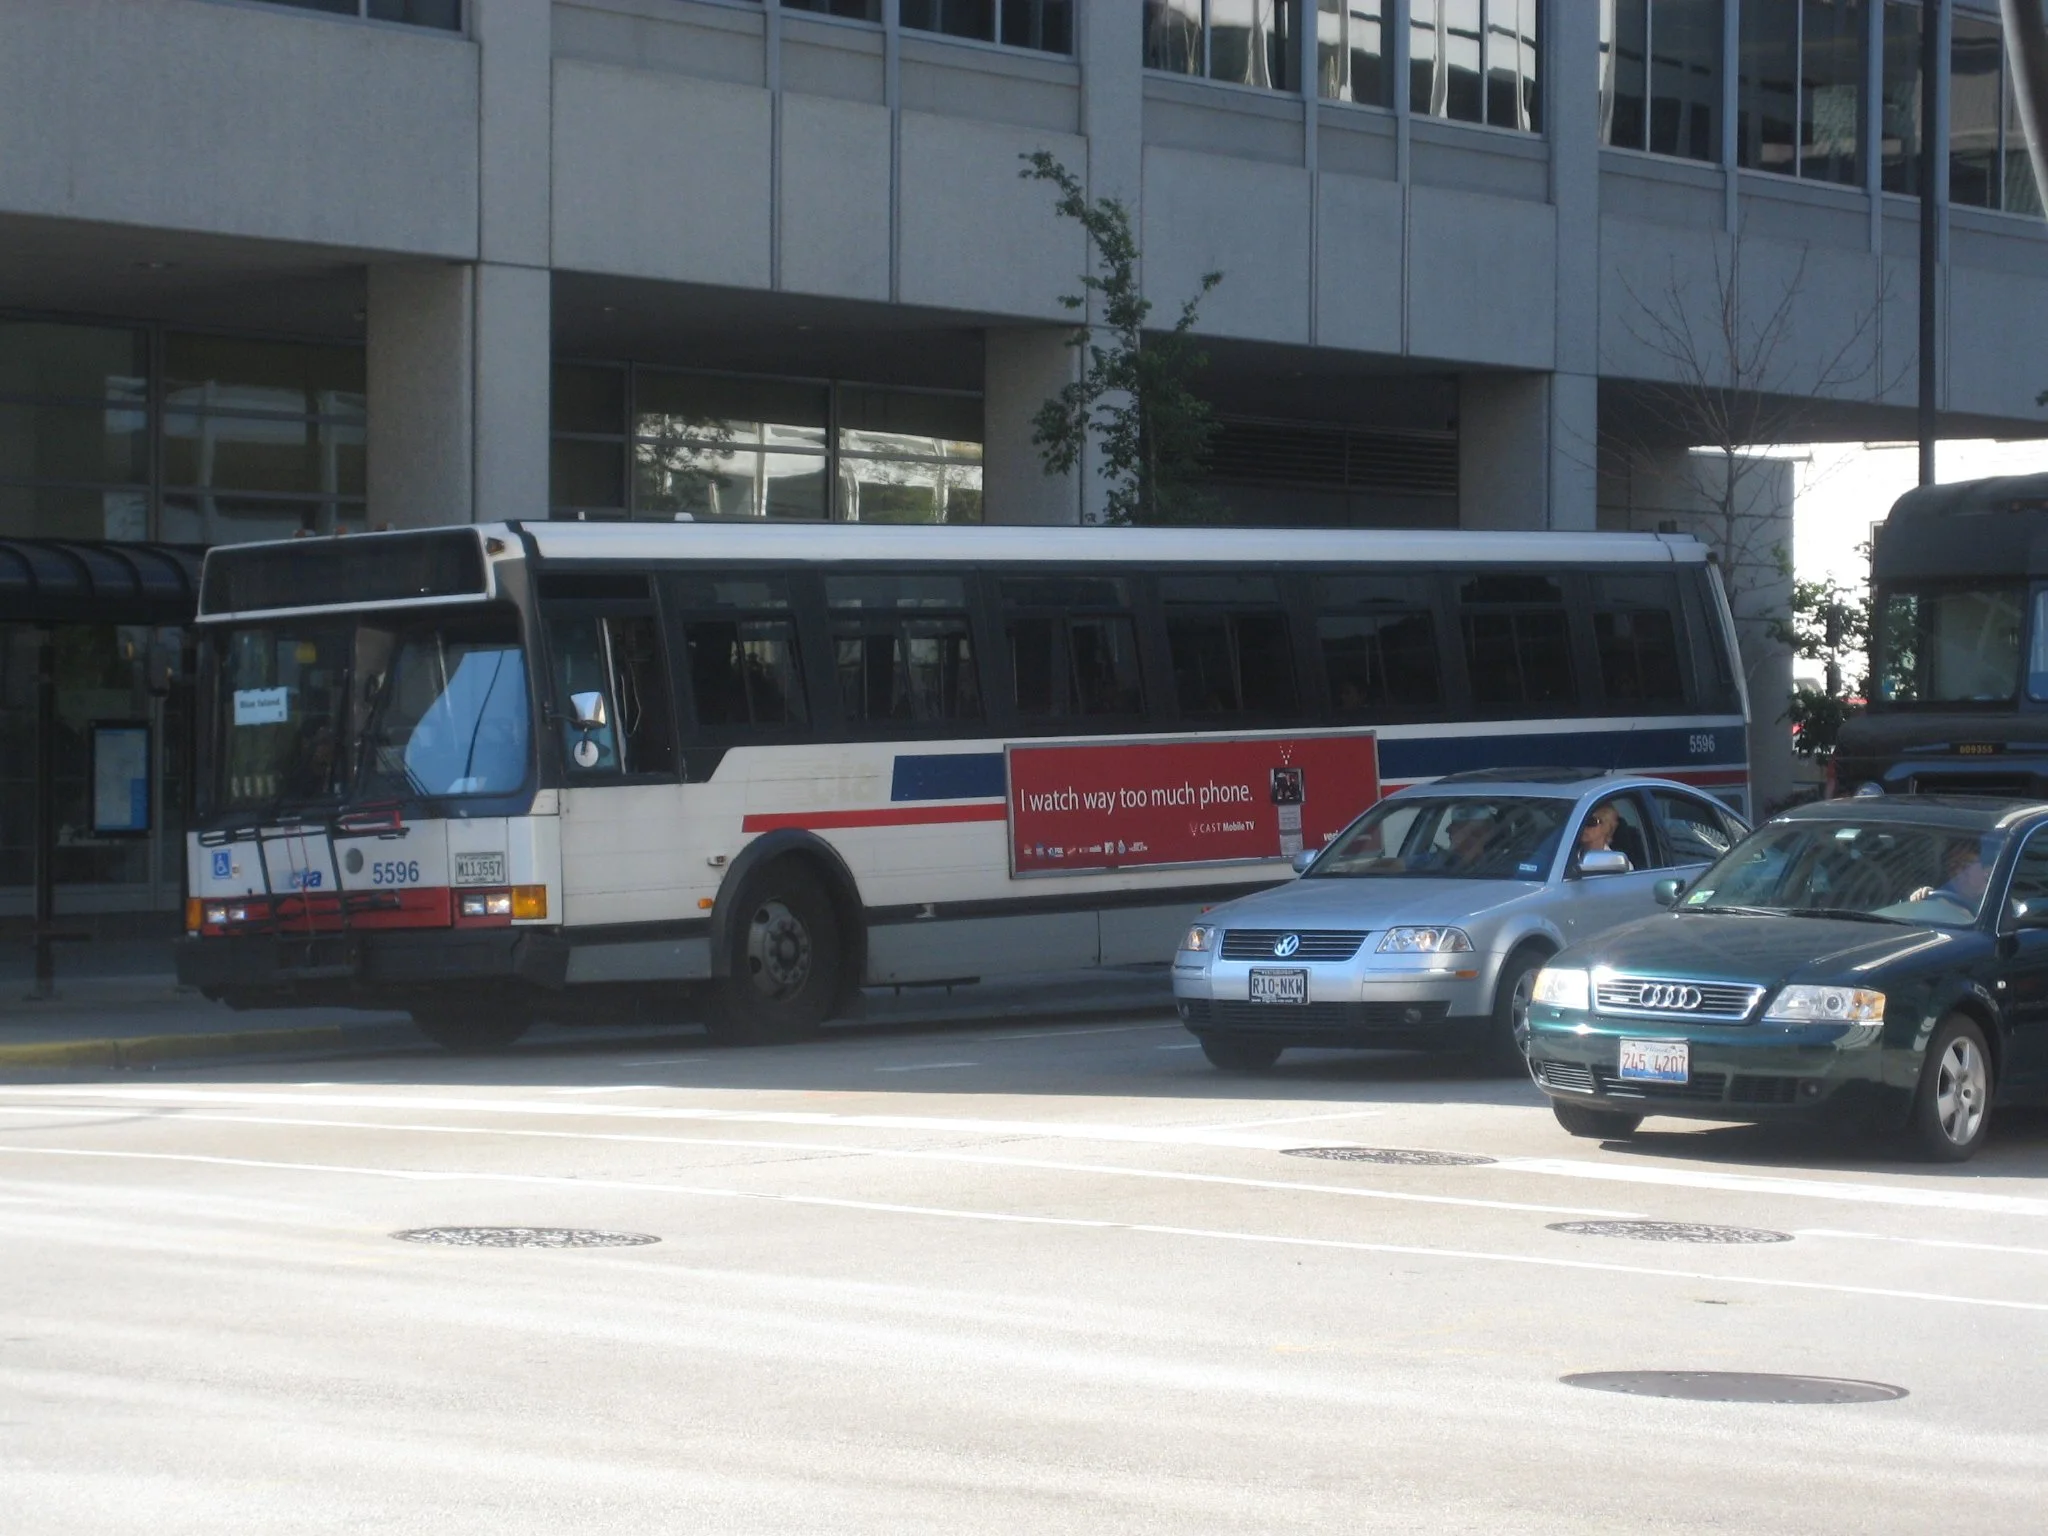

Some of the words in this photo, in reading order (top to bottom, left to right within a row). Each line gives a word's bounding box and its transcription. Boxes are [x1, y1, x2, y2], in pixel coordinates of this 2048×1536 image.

[1690, 734, 1715, 753] 5596
[1021, 788, 1026, 813] I
[1029, 786, 1079, 812] watch
[1083, 790, 1116, 815] way
[1120, 787, 1148, 809] too
[1151, 781, 1196, 806] much
[1199, 780, 1254, 810] phone.
[1223, 821, 1245, 832] Mobile
[1245, 820, 1255, 831] TV
[372, 860, 420, 885] 5596
[1623, 1052, 1646, 1072] 245
[1654, 1054, 1686, 1073] 4207
